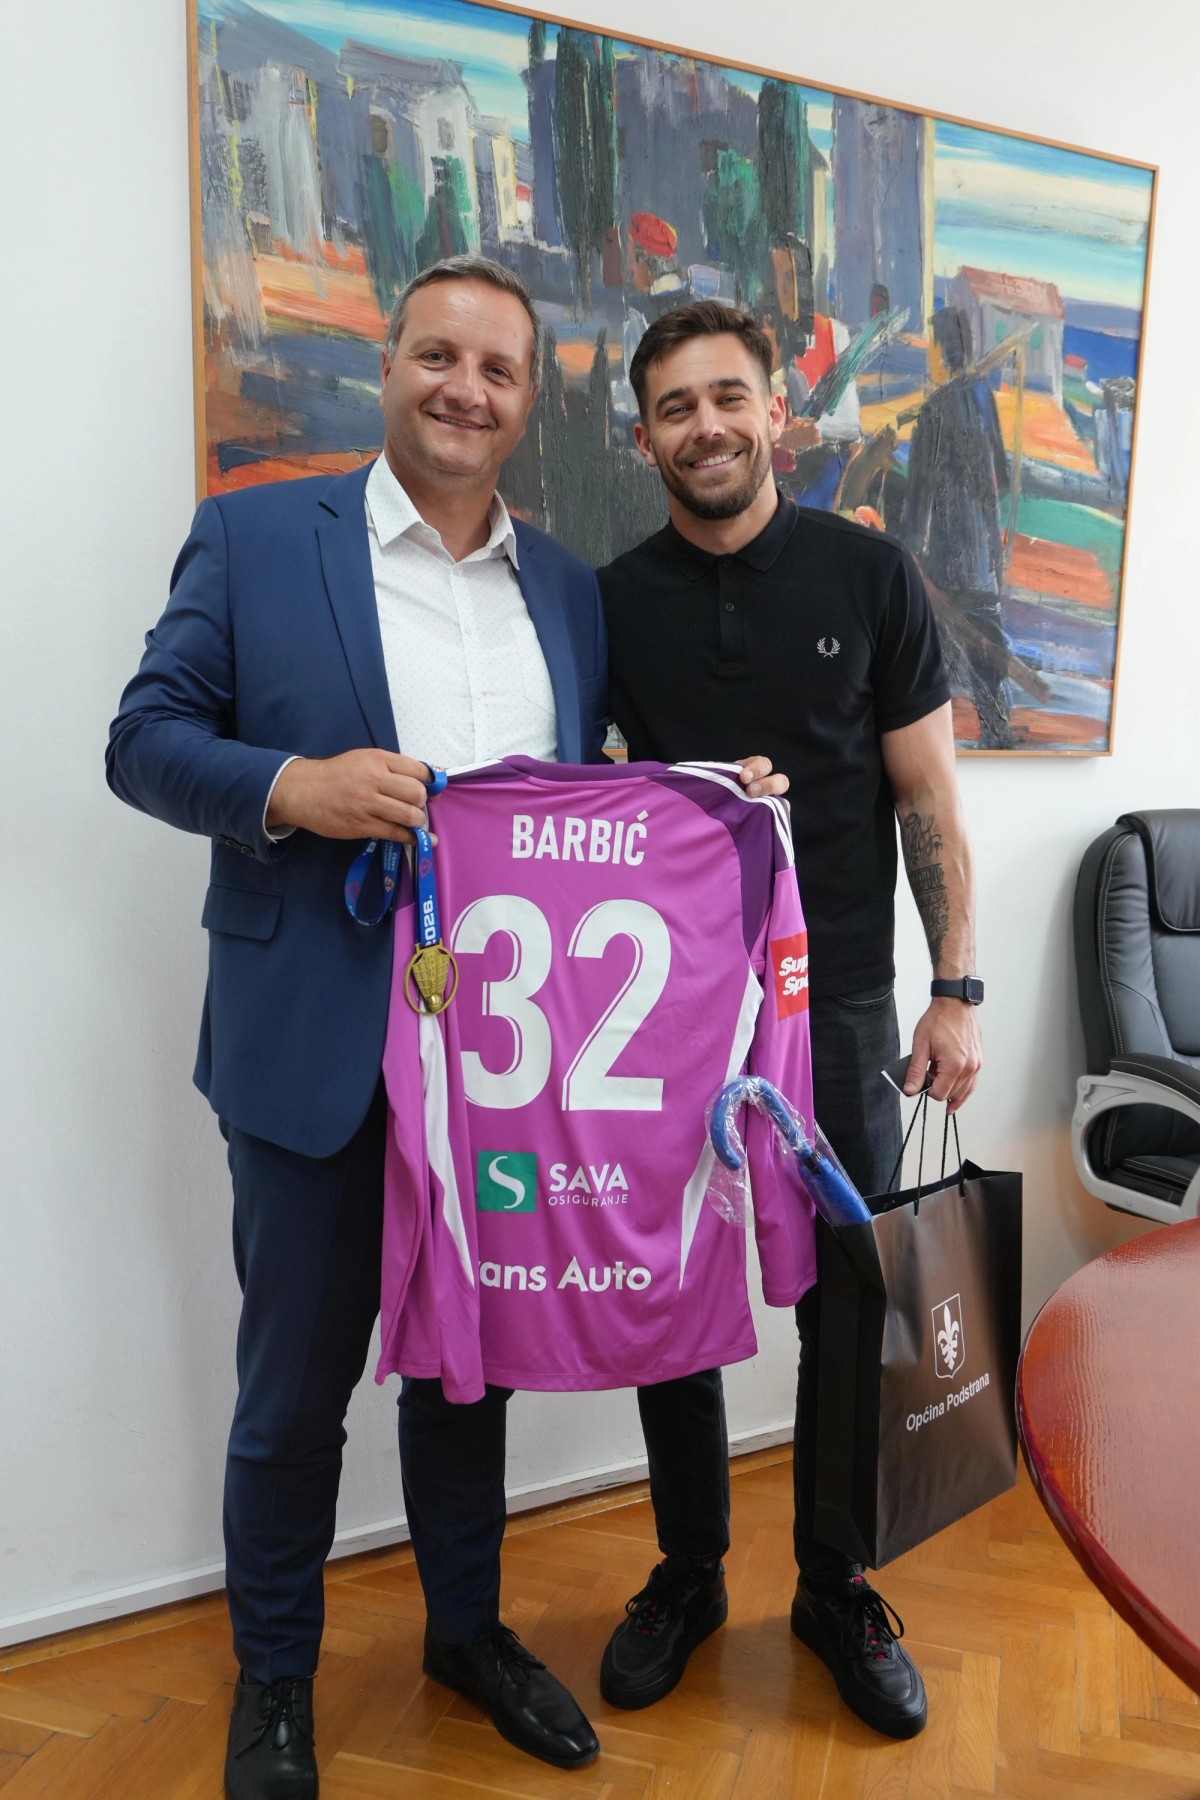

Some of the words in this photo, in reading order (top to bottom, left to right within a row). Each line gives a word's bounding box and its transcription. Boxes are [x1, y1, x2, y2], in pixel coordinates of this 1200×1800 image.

[511, 809, 648, 866] BARBIĆ
[450, 894, 672, 1112] 32
[548, 1194, 628, 1208] OSIGURANJE
[549, 1163, 629, 1194] SAVA
[478, 1261, 547, 1291] ans
[557, 1255, 652, 1292] Auto
[906, 1401, 945, 1432] Općina
[946, 1372, 990, 1412] Podstrana
